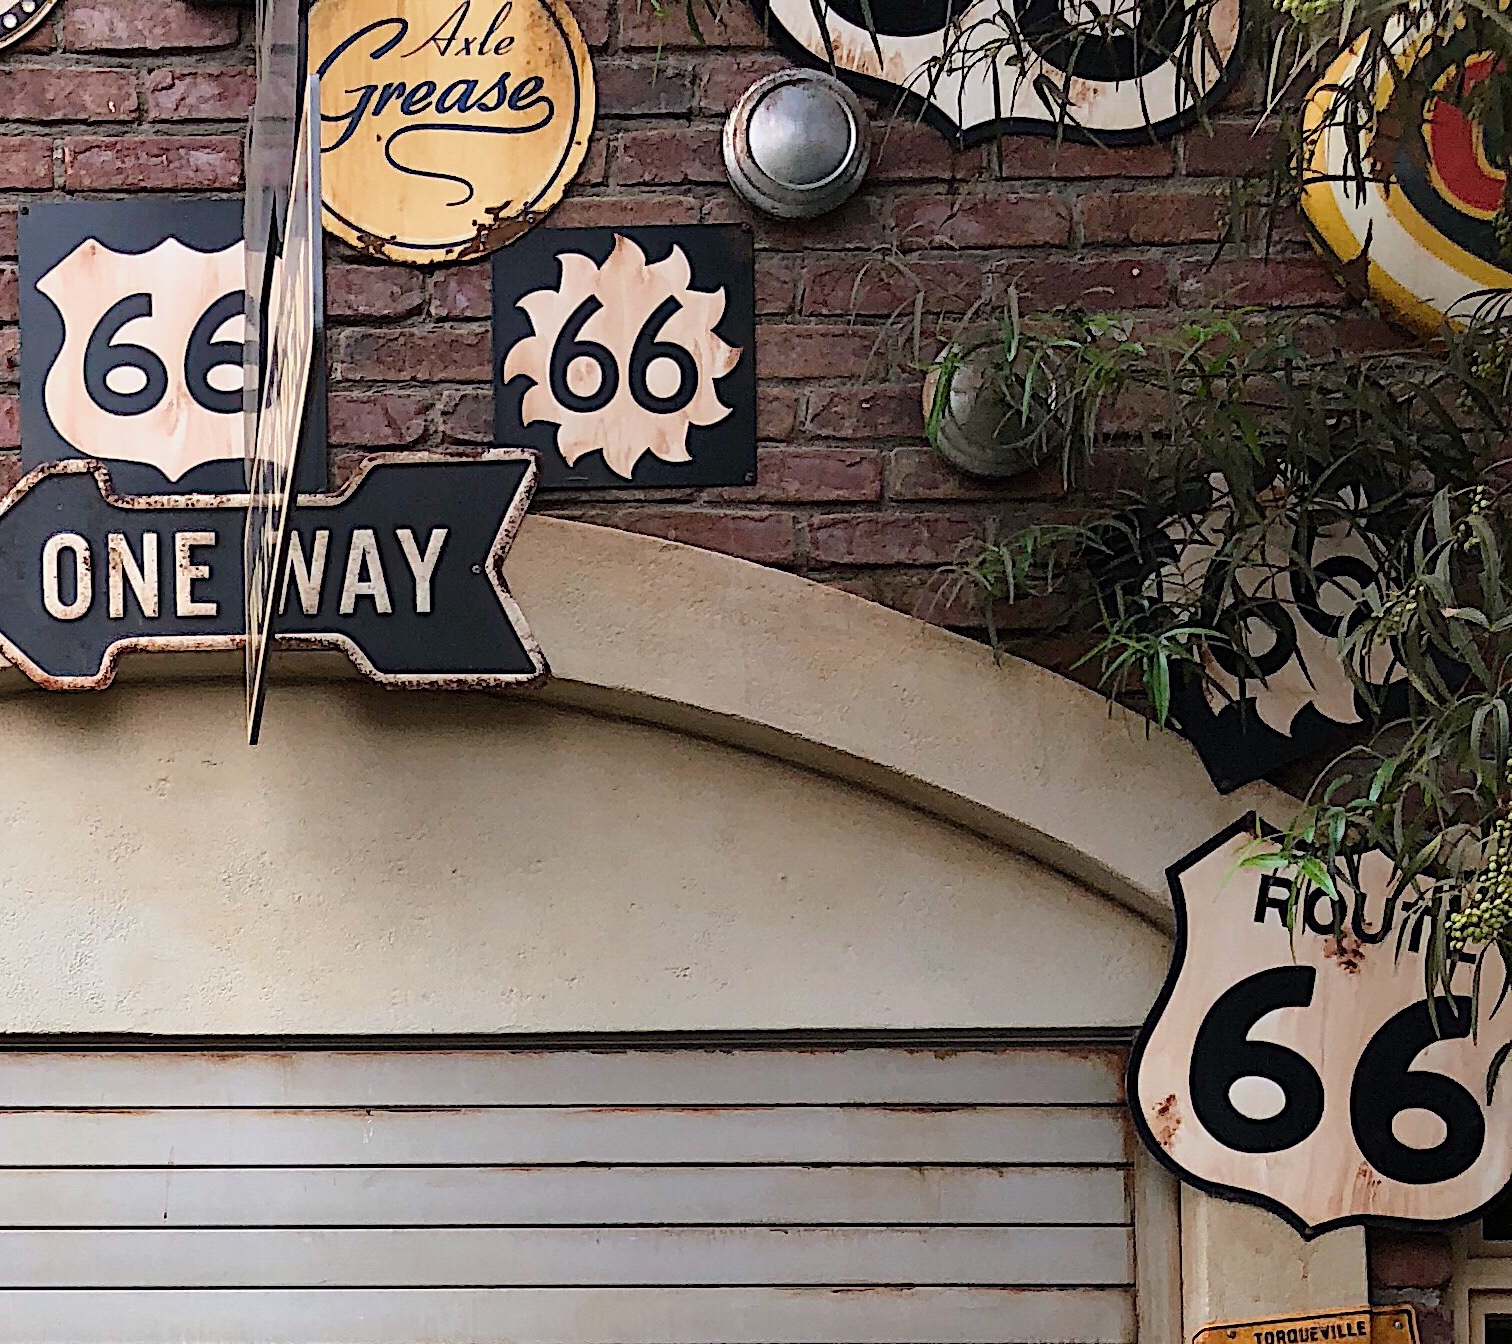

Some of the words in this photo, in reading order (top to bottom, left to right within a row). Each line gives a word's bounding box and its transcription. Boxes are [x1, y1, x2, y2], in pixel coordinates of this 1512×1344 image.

[317, 17, 550, 153] Grease
[400, 0, 515, 57] Axle
[84, 292, 256, 414] 66
[549, 294, 699, 414] 66
[42, 530, 219, 620] ONE
[270, 528, 449, 615] WAY
[1189, 965, 1486, 1184] 66
